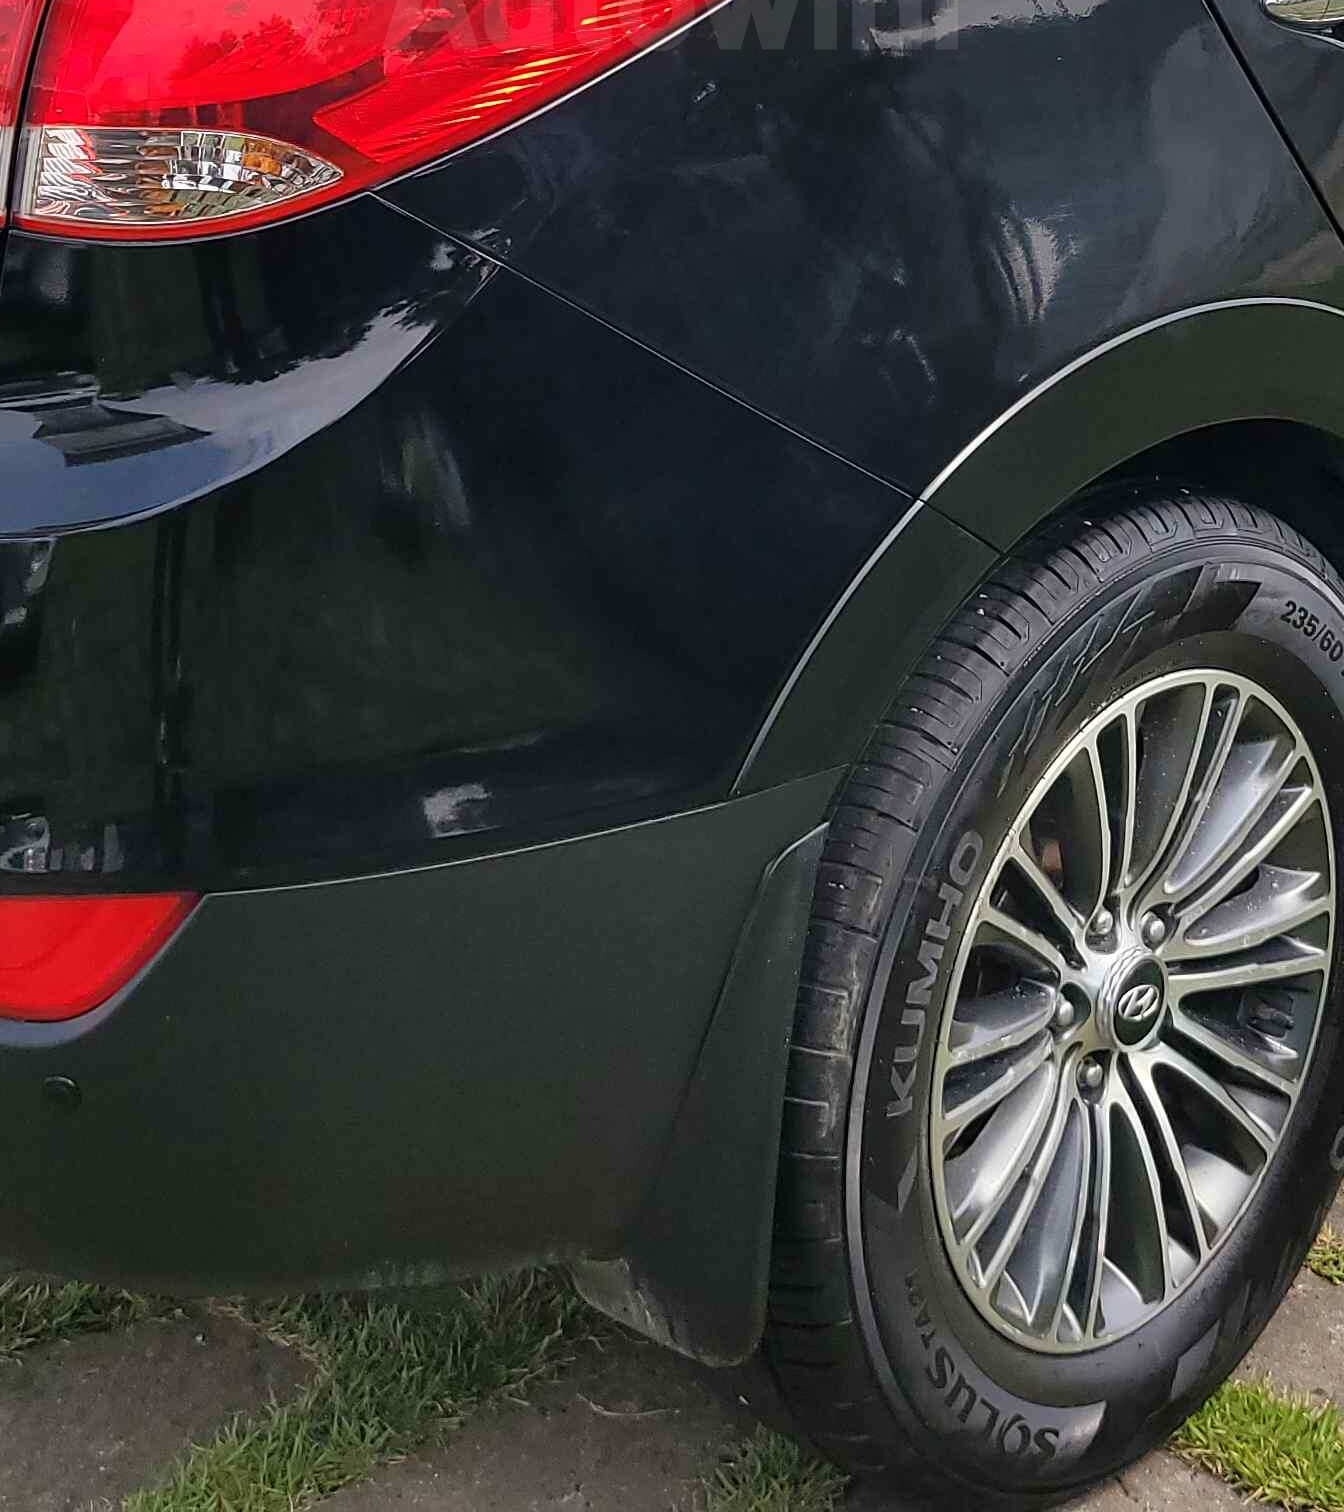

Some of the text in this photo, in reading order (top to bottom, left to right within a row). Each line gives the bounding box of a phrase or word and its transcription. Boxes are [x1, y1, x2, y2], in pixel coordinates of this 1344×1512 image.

[1280, 600, 1344, 662] 235/60
[886, 830, 984, 1118] KUMHO
[925, 1345, 1060, 1460] SOLUS
